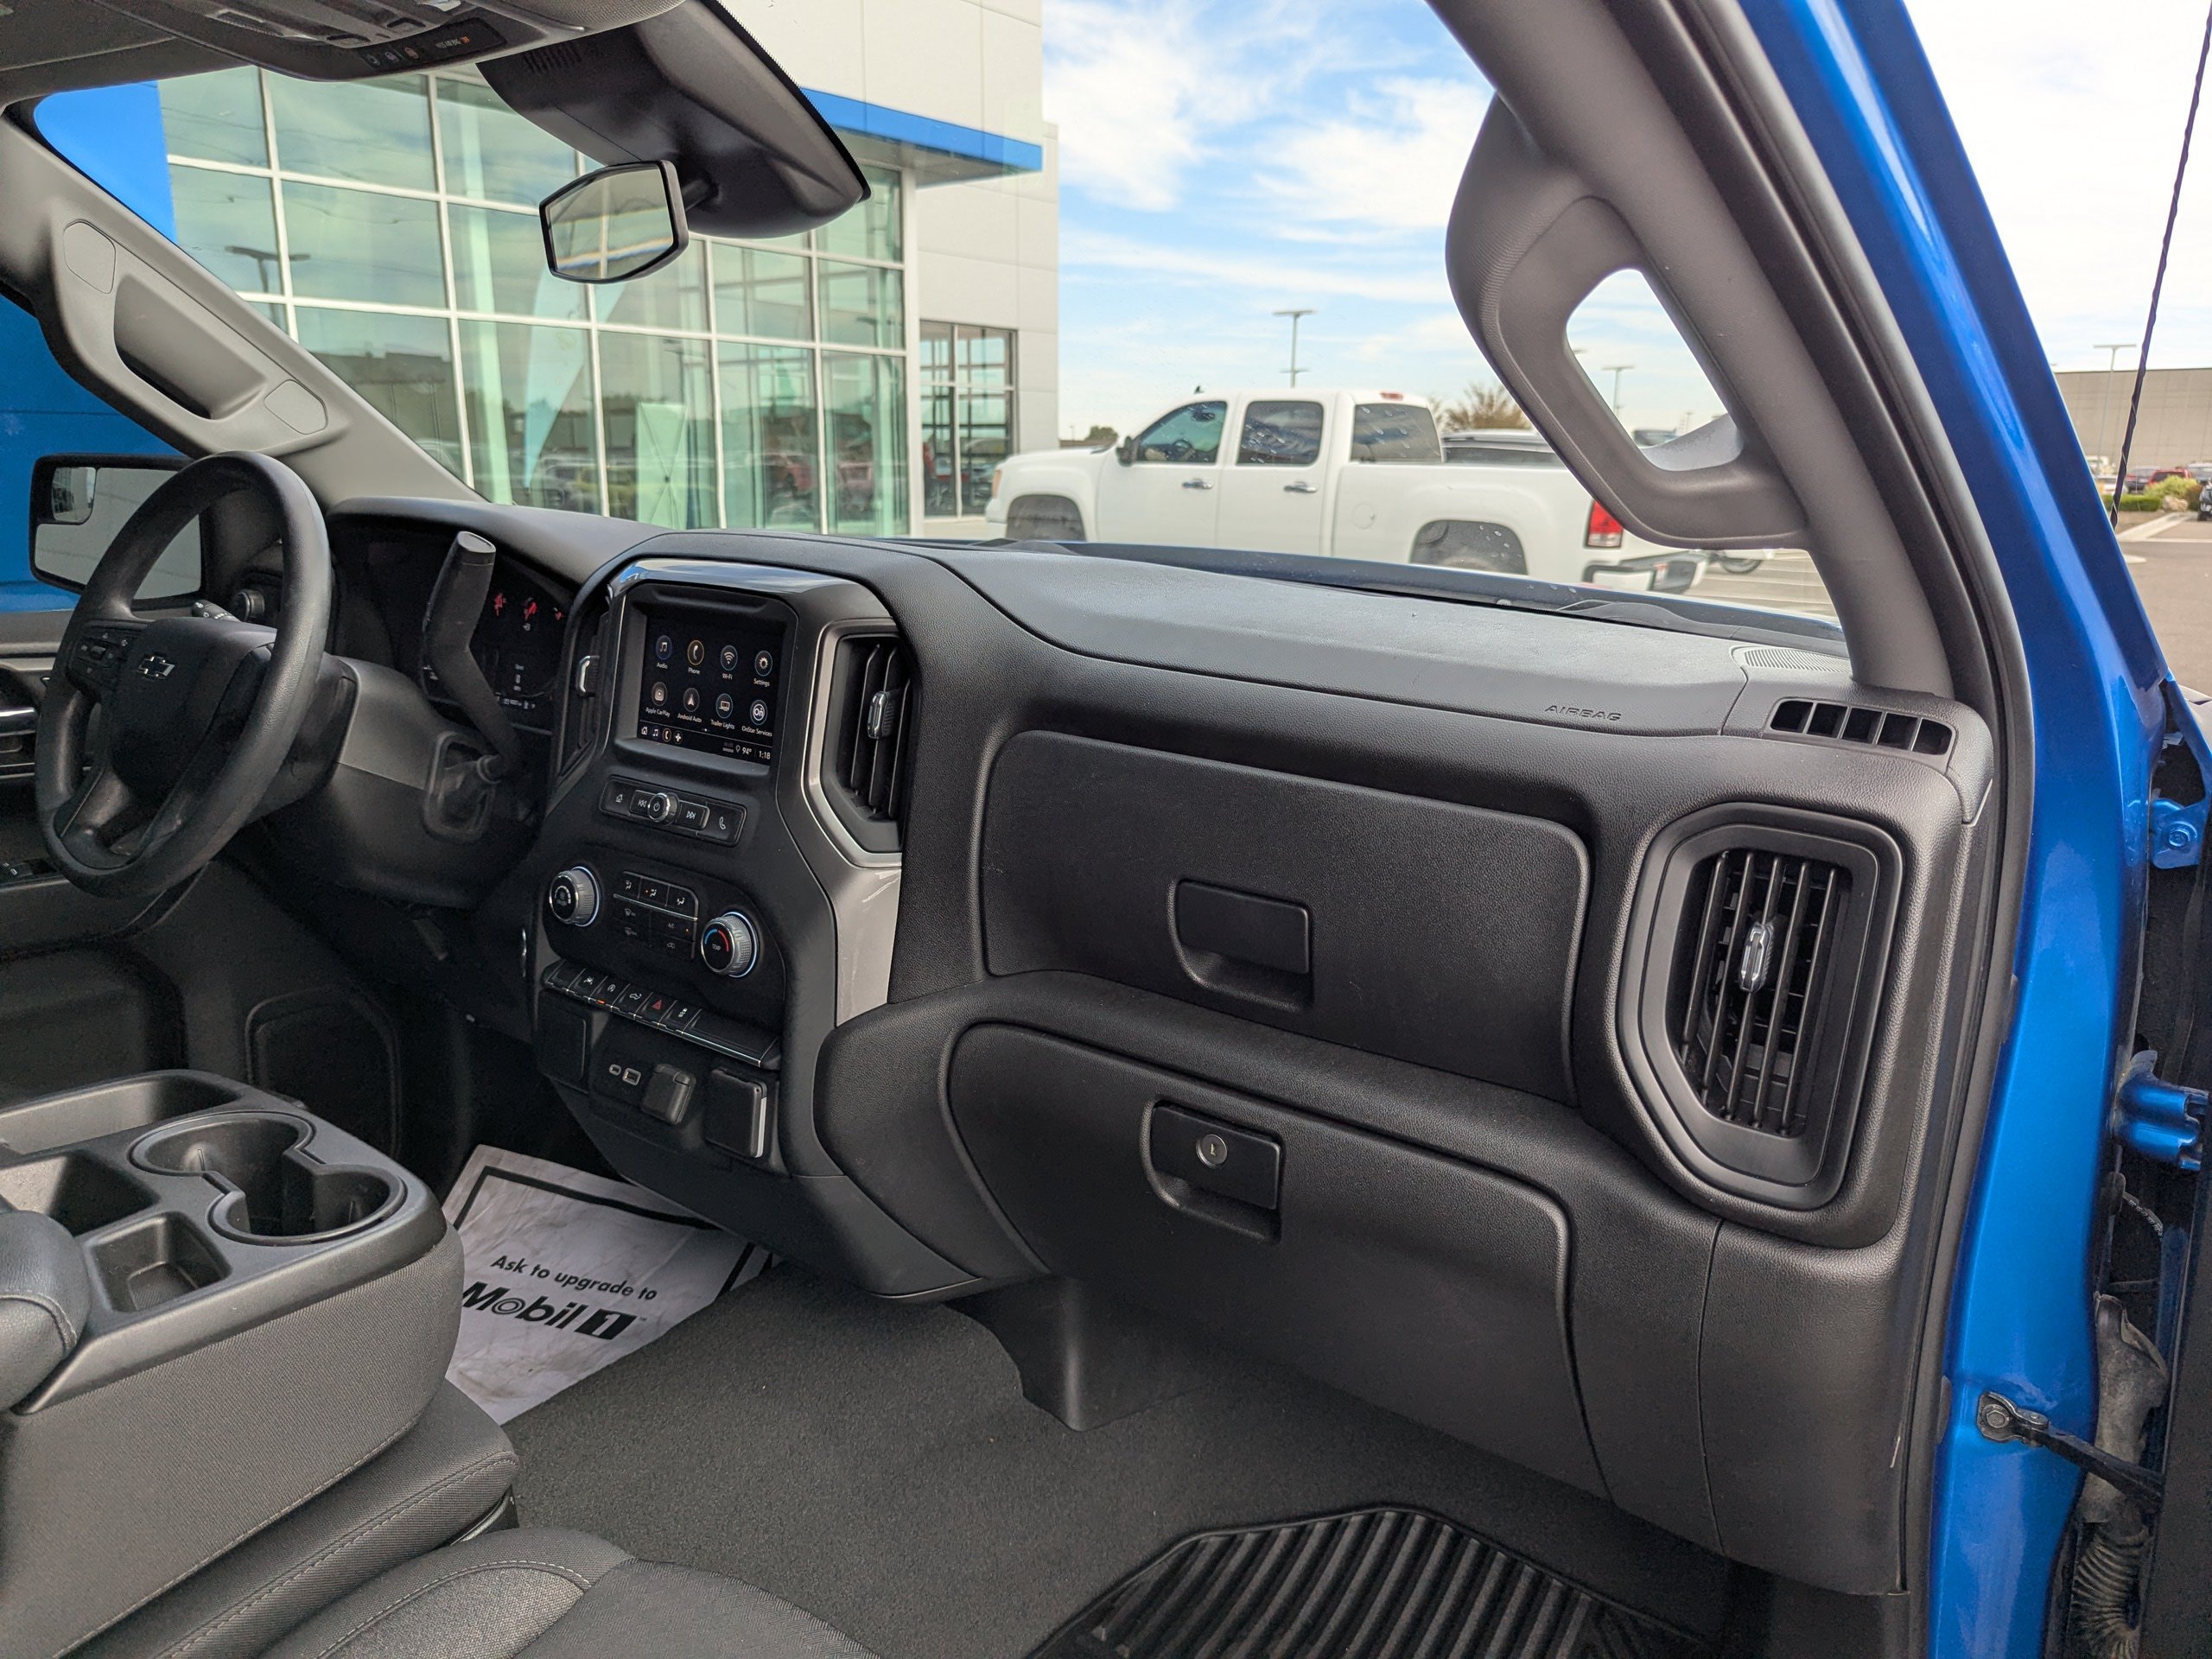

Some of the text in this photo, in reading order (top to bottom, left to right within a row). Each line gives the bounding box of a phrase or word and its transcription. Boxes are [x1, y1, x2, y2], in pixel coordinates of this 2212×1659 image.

[753, 678, 770, 688] Settings
[1544, 705, 1622, 721] AIRBAG
[722, 721, 735, 730] Lights
[756, 728, 772, 737] Services
[759, 750, 771, 760] 1:18
[490, 1255, 658, 1300] Ask to upgrade to
[462, 1281, 589, 1329] Mobil
